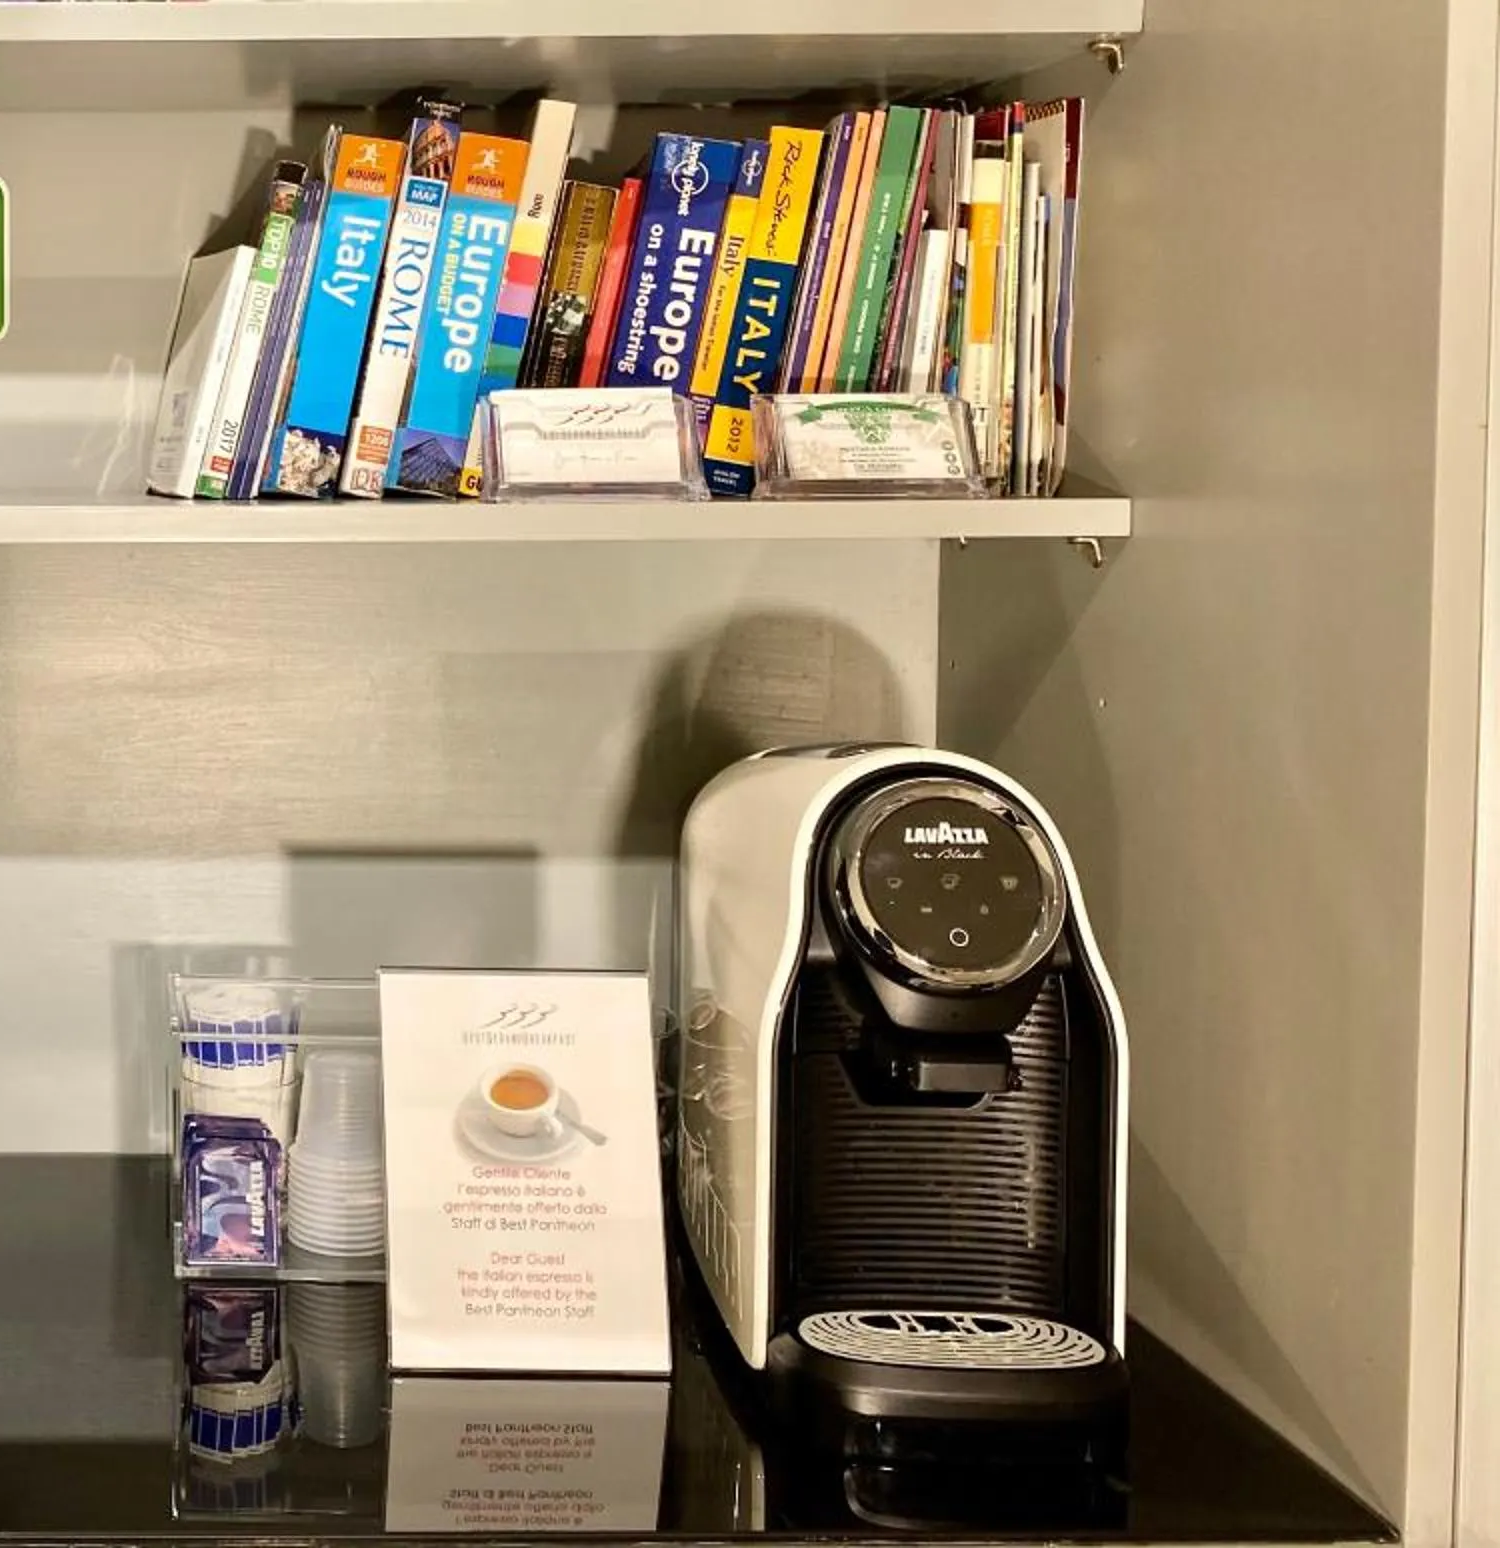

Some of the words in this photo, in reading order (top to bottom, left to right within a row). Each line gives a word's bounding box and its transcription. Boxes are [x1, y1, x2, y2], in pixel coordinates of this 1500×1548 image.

[348, 168, 387, 182] ROUGH
[779, 140, 803, 189] Rick
[467, 175, 505, 188] ROUGH
[403, 210, 437, 229] 2014
[647, 223, 664, 249] on
[321, 215, 382, 308] Italy
[643, 255, 658, 267] a
[720, 235, 745, 278] Italy
[379, 236, 430, 359] ROME
[442, 214, 510, 374] Europe
[650, 228, 716, 381] Europe
[246, 285, 271, 335] ROME
[617, 272, 657, 376] shoestring
[733, 277, 781, 395] ITALY
[219, 419, 239, 453] 2017
[726, 417, 743, 453] 2012
[904, 821, 989, 845] LAVAZZA
[472, 1166, 519, 1179] Gentile
[523, 1167, 571, 1180] Cliente
[442, 1200, 523, 1215] gentilmente
[527, 1201, 571, 1215] offerto
[451, 1217, 482, 1230] Staff
[500, 1217, 528, 1231] Best
[530, 1218, 595, 1232] Pantheon
[490, 1252, 523, 1265] Dear
[526, 1252, 565, 1266] Guest
[457, 1268, 479, 1281] the
[525, 1270, 583, 1285] espresso
[461, 1285, 499, 1300] kindly
[502, 1286, 551, 1299] offered
[555, 1287, 571, 1302] by
[575, 1287, 597, 1300] the
[465, 1302, 492, 1315] Best
[496, 1303, 561, 1318] Pantheon
[564, 1304, 596, 1319] Staff
